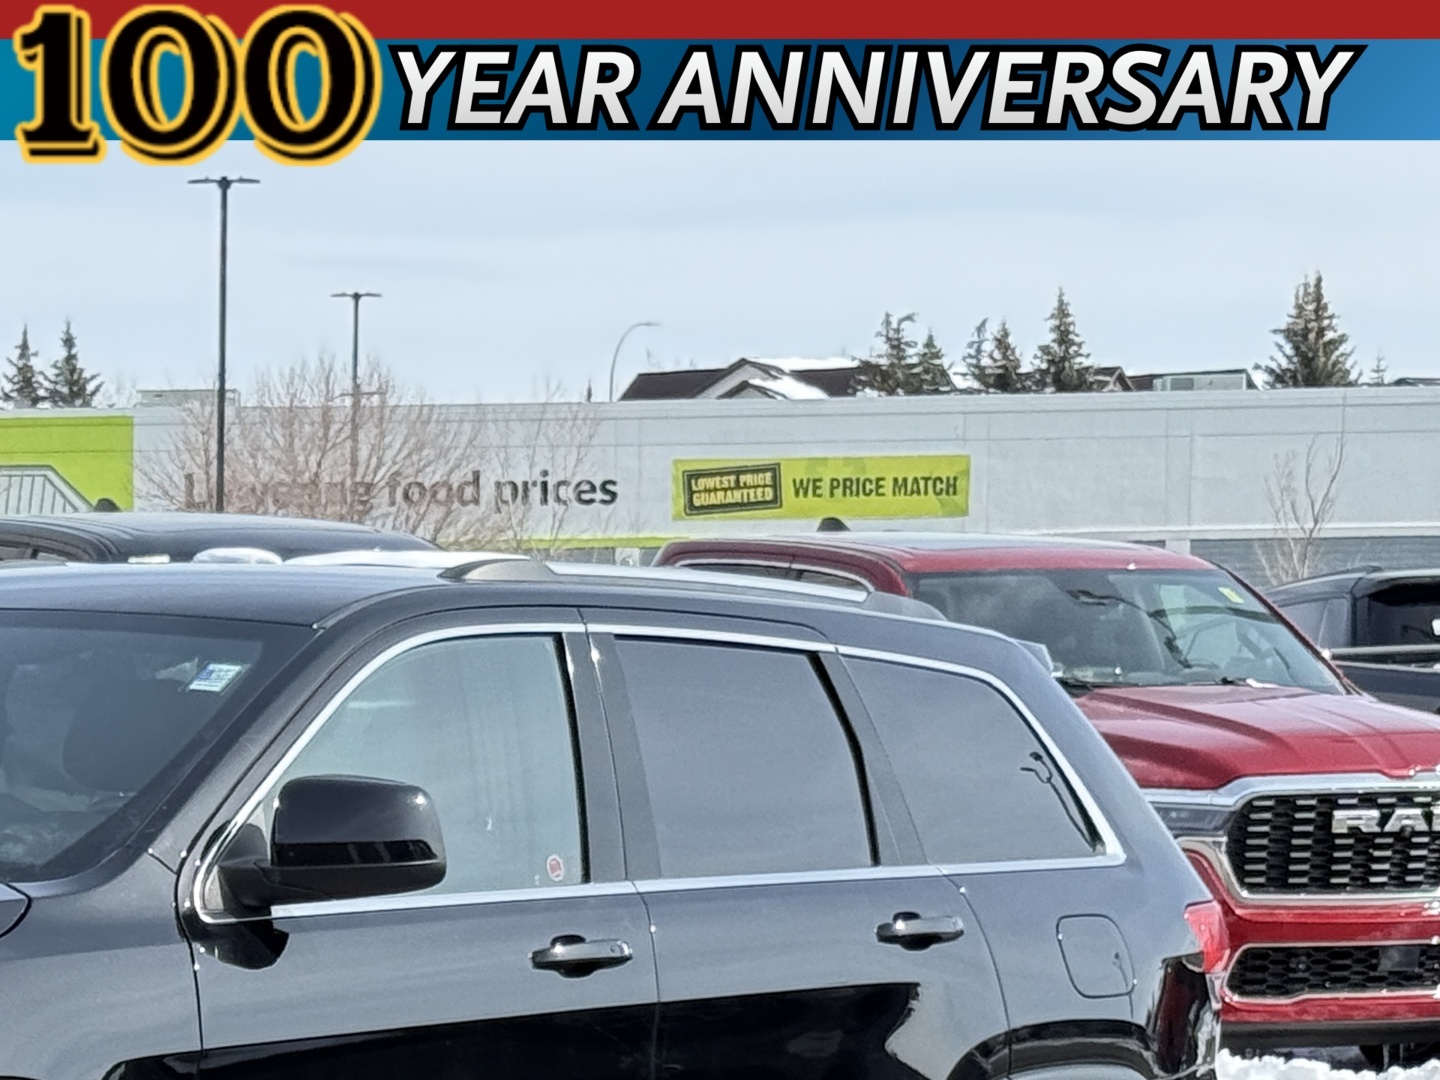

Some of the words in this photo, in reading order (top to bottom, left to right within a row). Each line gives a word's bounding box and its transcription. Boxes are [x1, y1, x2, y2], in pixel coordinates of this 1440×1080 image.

[386, 470, 481, 507] food
[494, 469, 619, 514] prices
[691, 475, 736, 491] LOWEST
[739, 472, 773, 487] PRICE
[792, 477, 823, 498] WE
[829, 476, 886, 498] PRICE
[892, 476, 958, 497] MATCH
[692, 487, 774, 506] GUARANTEED
